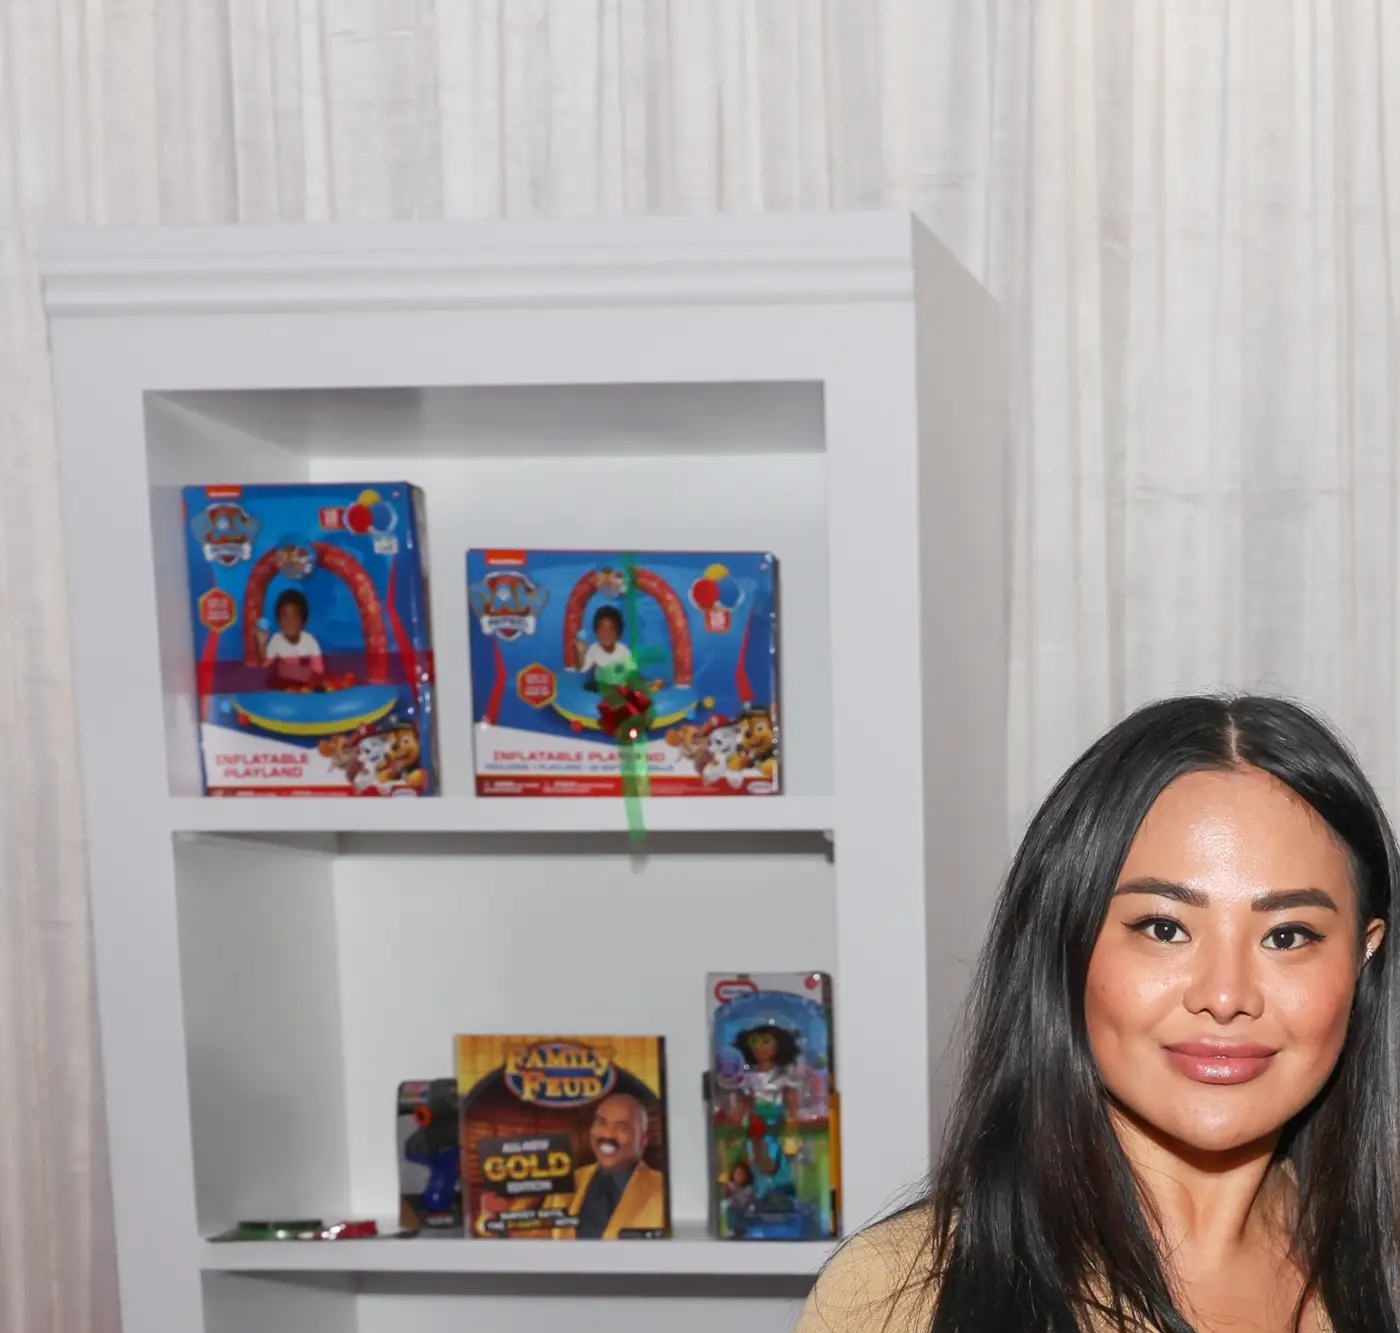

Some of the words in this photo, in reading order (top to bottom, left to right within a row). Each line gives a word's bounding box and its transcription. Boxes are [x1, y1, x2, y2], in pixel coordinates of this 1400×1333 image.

[471, 576, 548, 615] PAW
[216, 754, 309, 766] INFLATABLE
[493, 751, 583, 763] INFLATABLE
[223, 766, 303, 778] PLAYLAND
[505, 1046, 612, 1076] FAMILY
[520, 1073, 602, 1100] FEUD
[483, 1152, 571, 1180] GOLD
